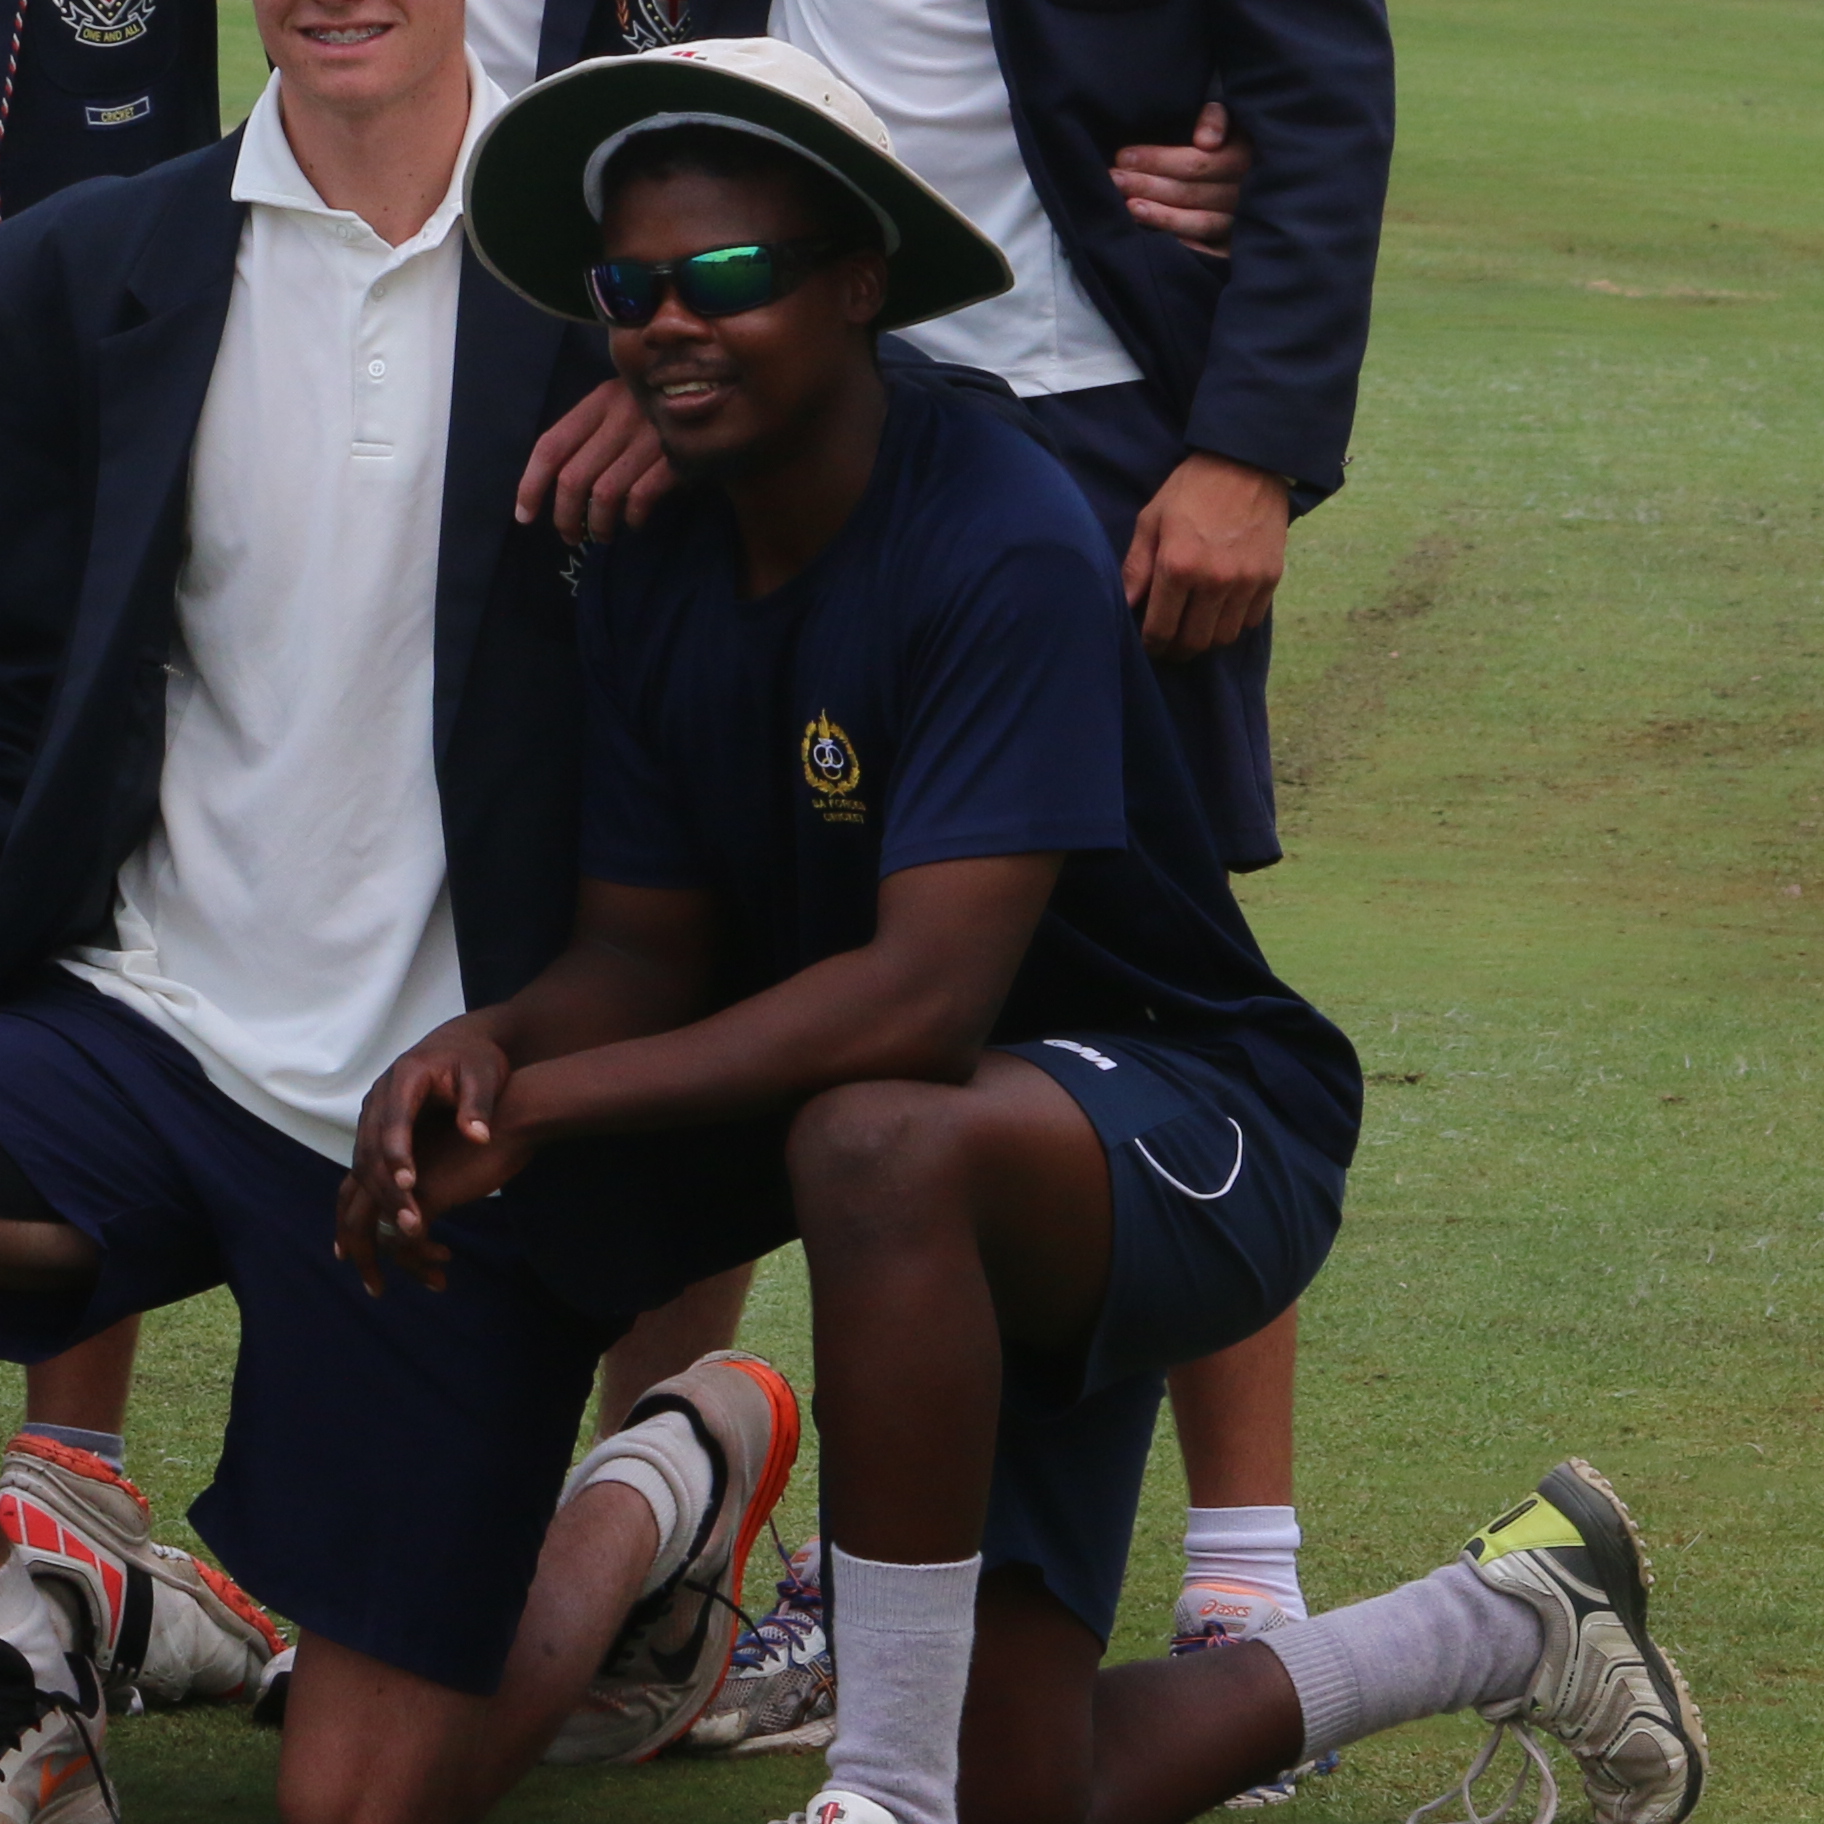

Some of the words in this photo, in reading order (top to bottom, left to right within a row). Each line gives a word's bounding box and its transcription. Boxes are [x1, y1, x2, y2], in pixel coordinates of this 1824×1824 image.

[82, 28, 101, 41] ONE
[103, 29, 123, 43] AND
[124, 23, 140, 38] ALL
